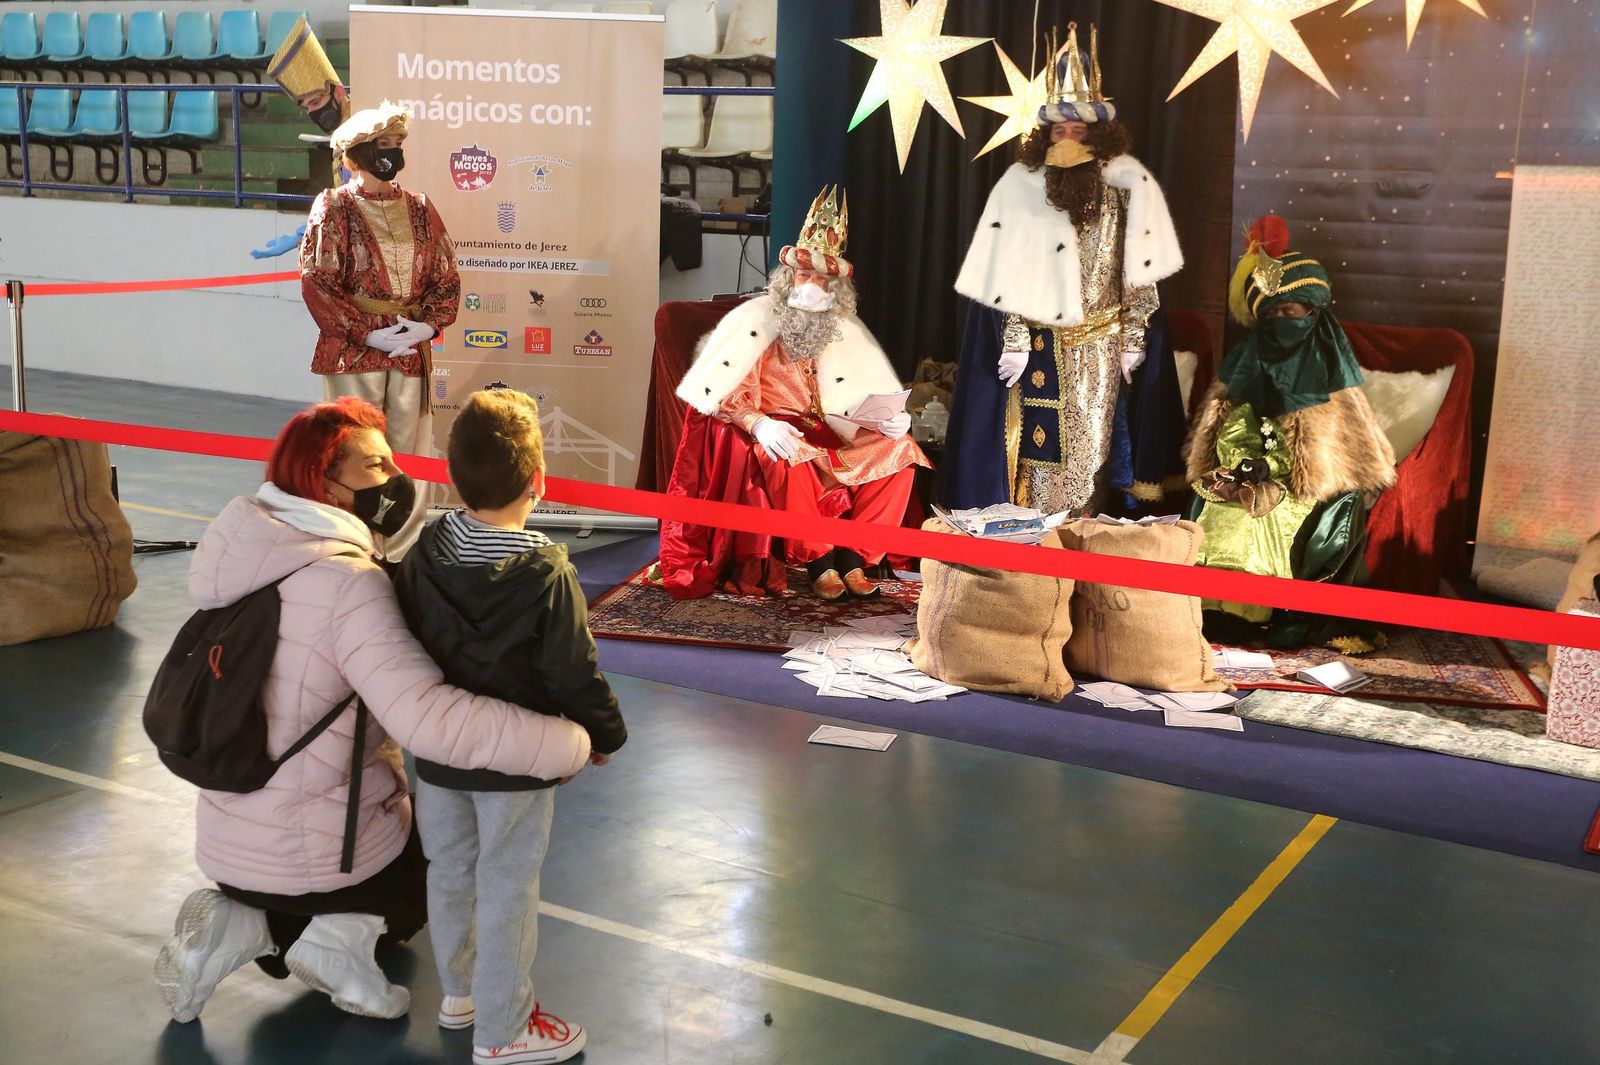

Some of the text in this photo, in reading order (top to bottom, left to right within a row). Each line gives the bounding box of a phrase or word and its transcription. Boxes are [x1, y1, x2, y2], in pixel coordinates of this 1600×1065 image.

[397, 53, 560, 84] Momentos
[399, 93, 592, 129] mágicos con:
[462, 154, 488, 164] Reyes
[454, 160, 492, 173] Magos
[525, 241, 538, 251] de
[540, 242, 568, 253] Jerez
[466, 258, 508, 268] diseñado
[509, 261, 526, 271] por
[527, 261, 549, 270] IKEA
[550, 262, 579, 271] JEREZ.
[468, 335, 504, 344] IKEA
